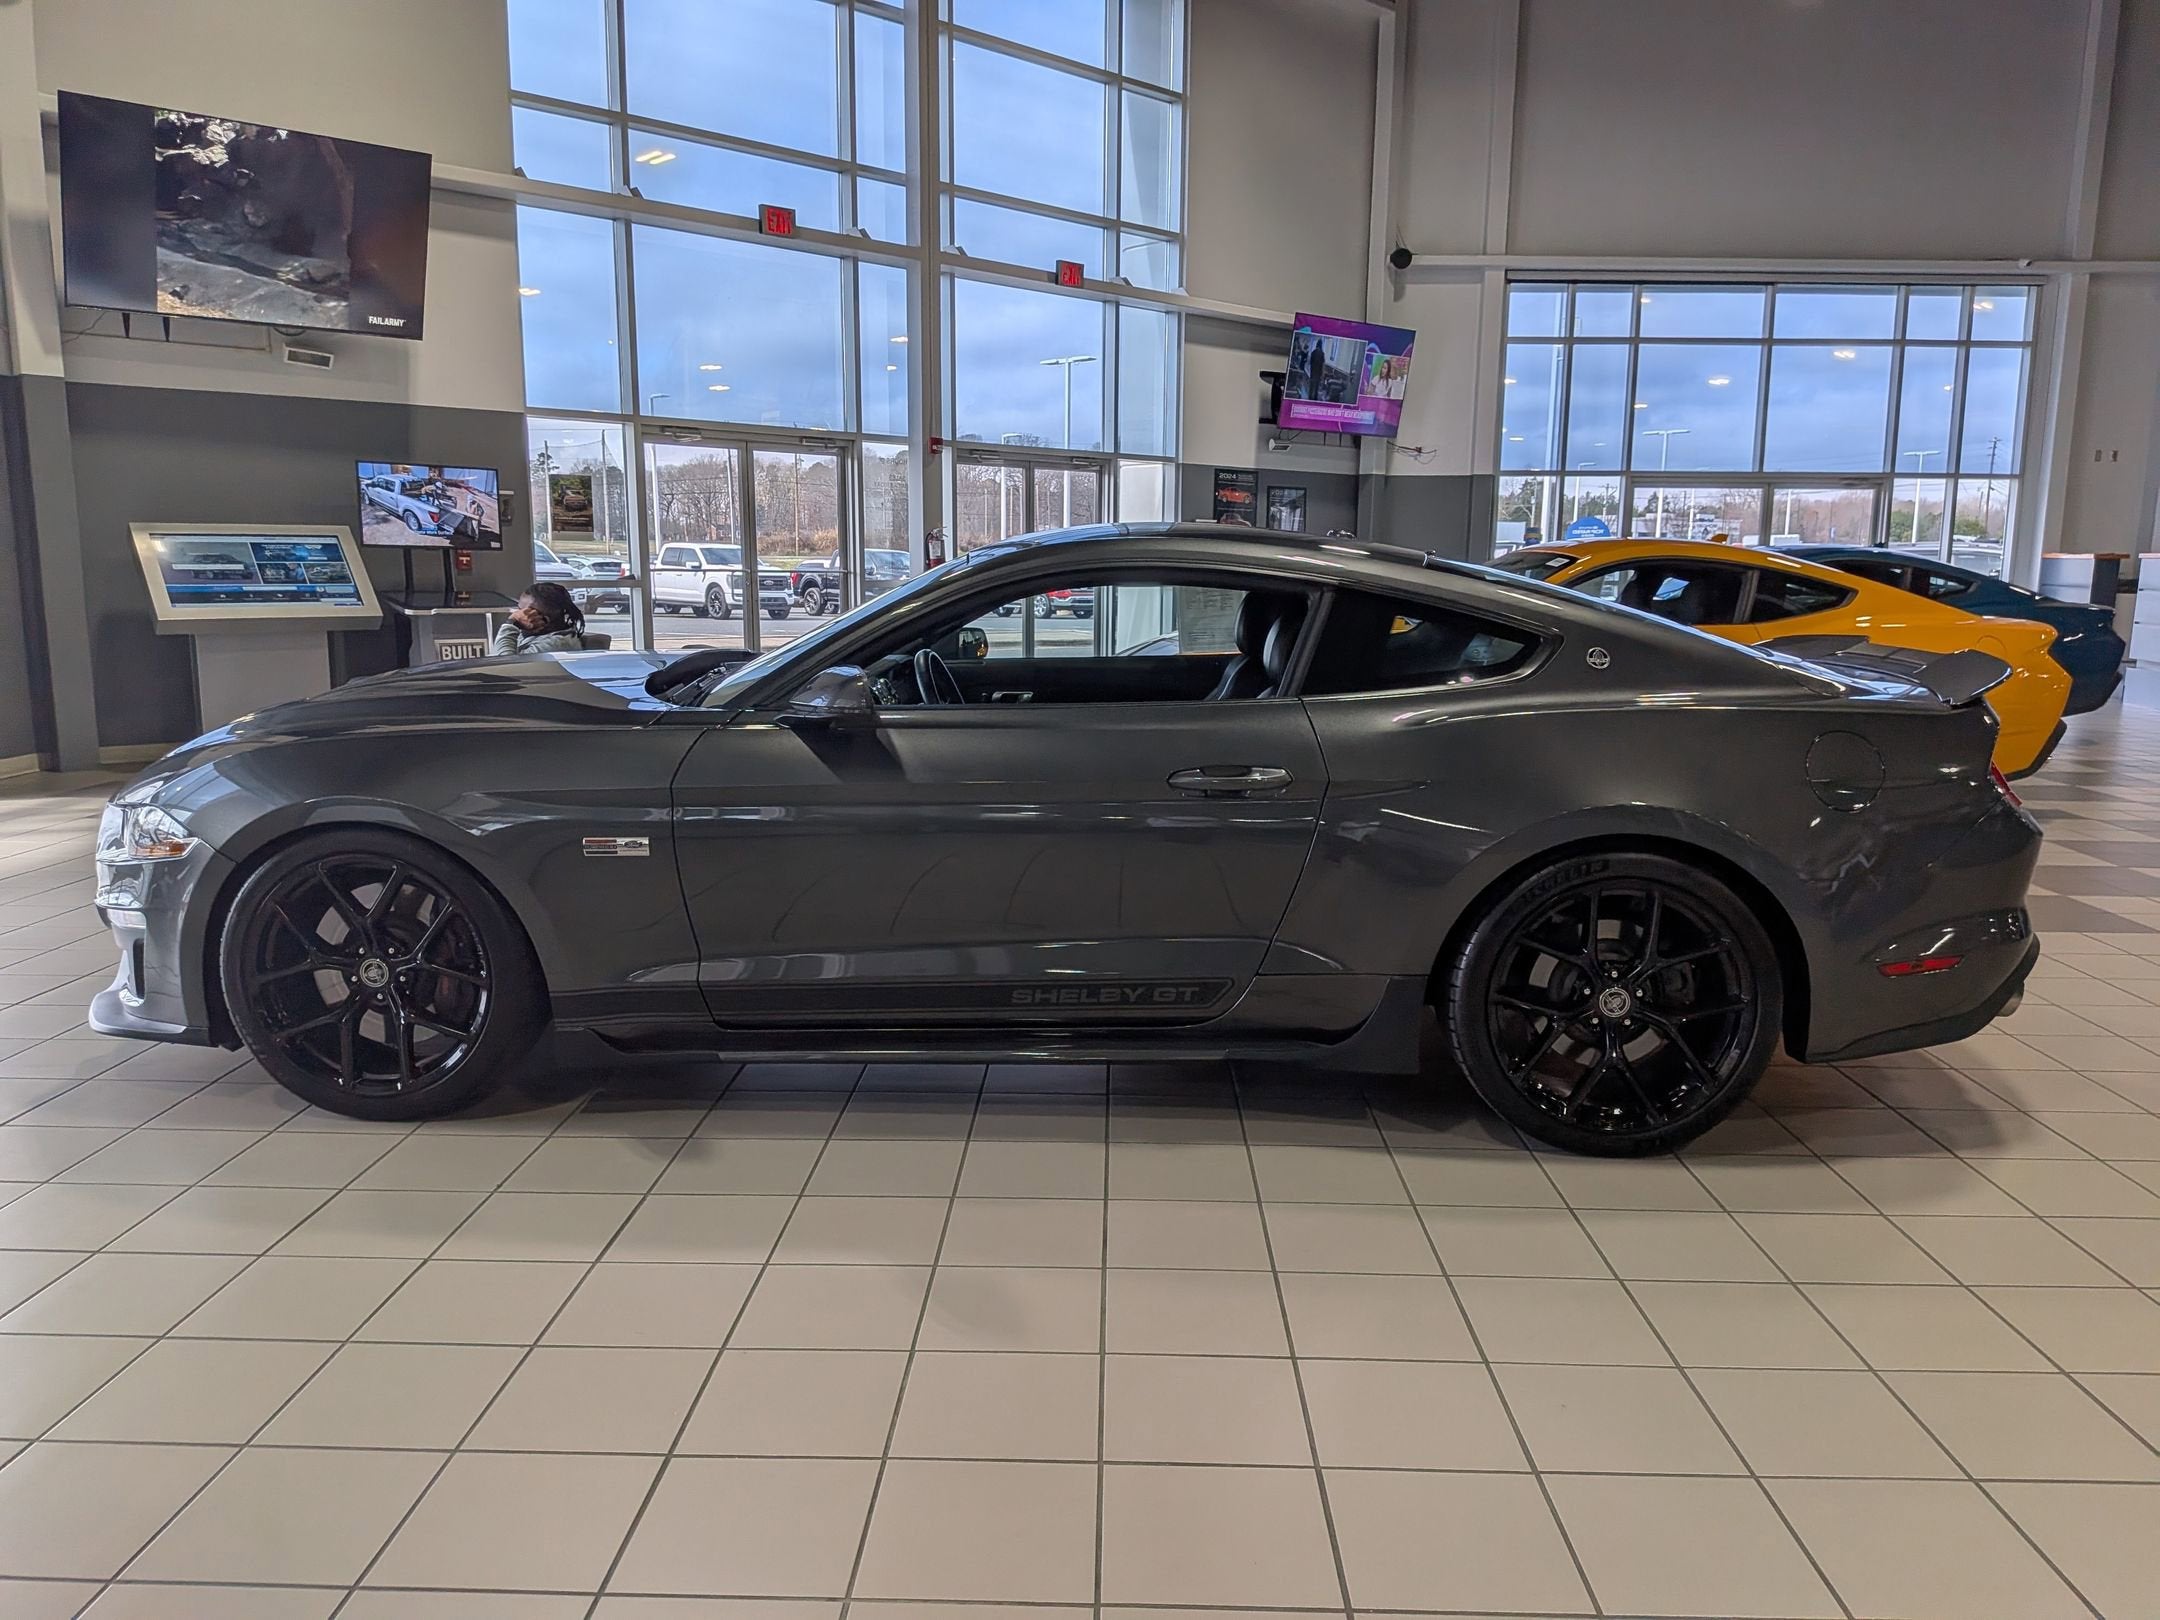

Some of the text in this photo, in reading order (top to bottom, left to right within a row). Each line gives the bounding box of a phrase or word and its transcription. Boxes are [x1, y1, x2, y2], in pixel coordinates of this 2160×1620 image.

[368, 315, 404, 327] FAILARMY
[441, 645, 482, 660] BUILT
[1011, 987, 1200, 1004] SHELBY GT
